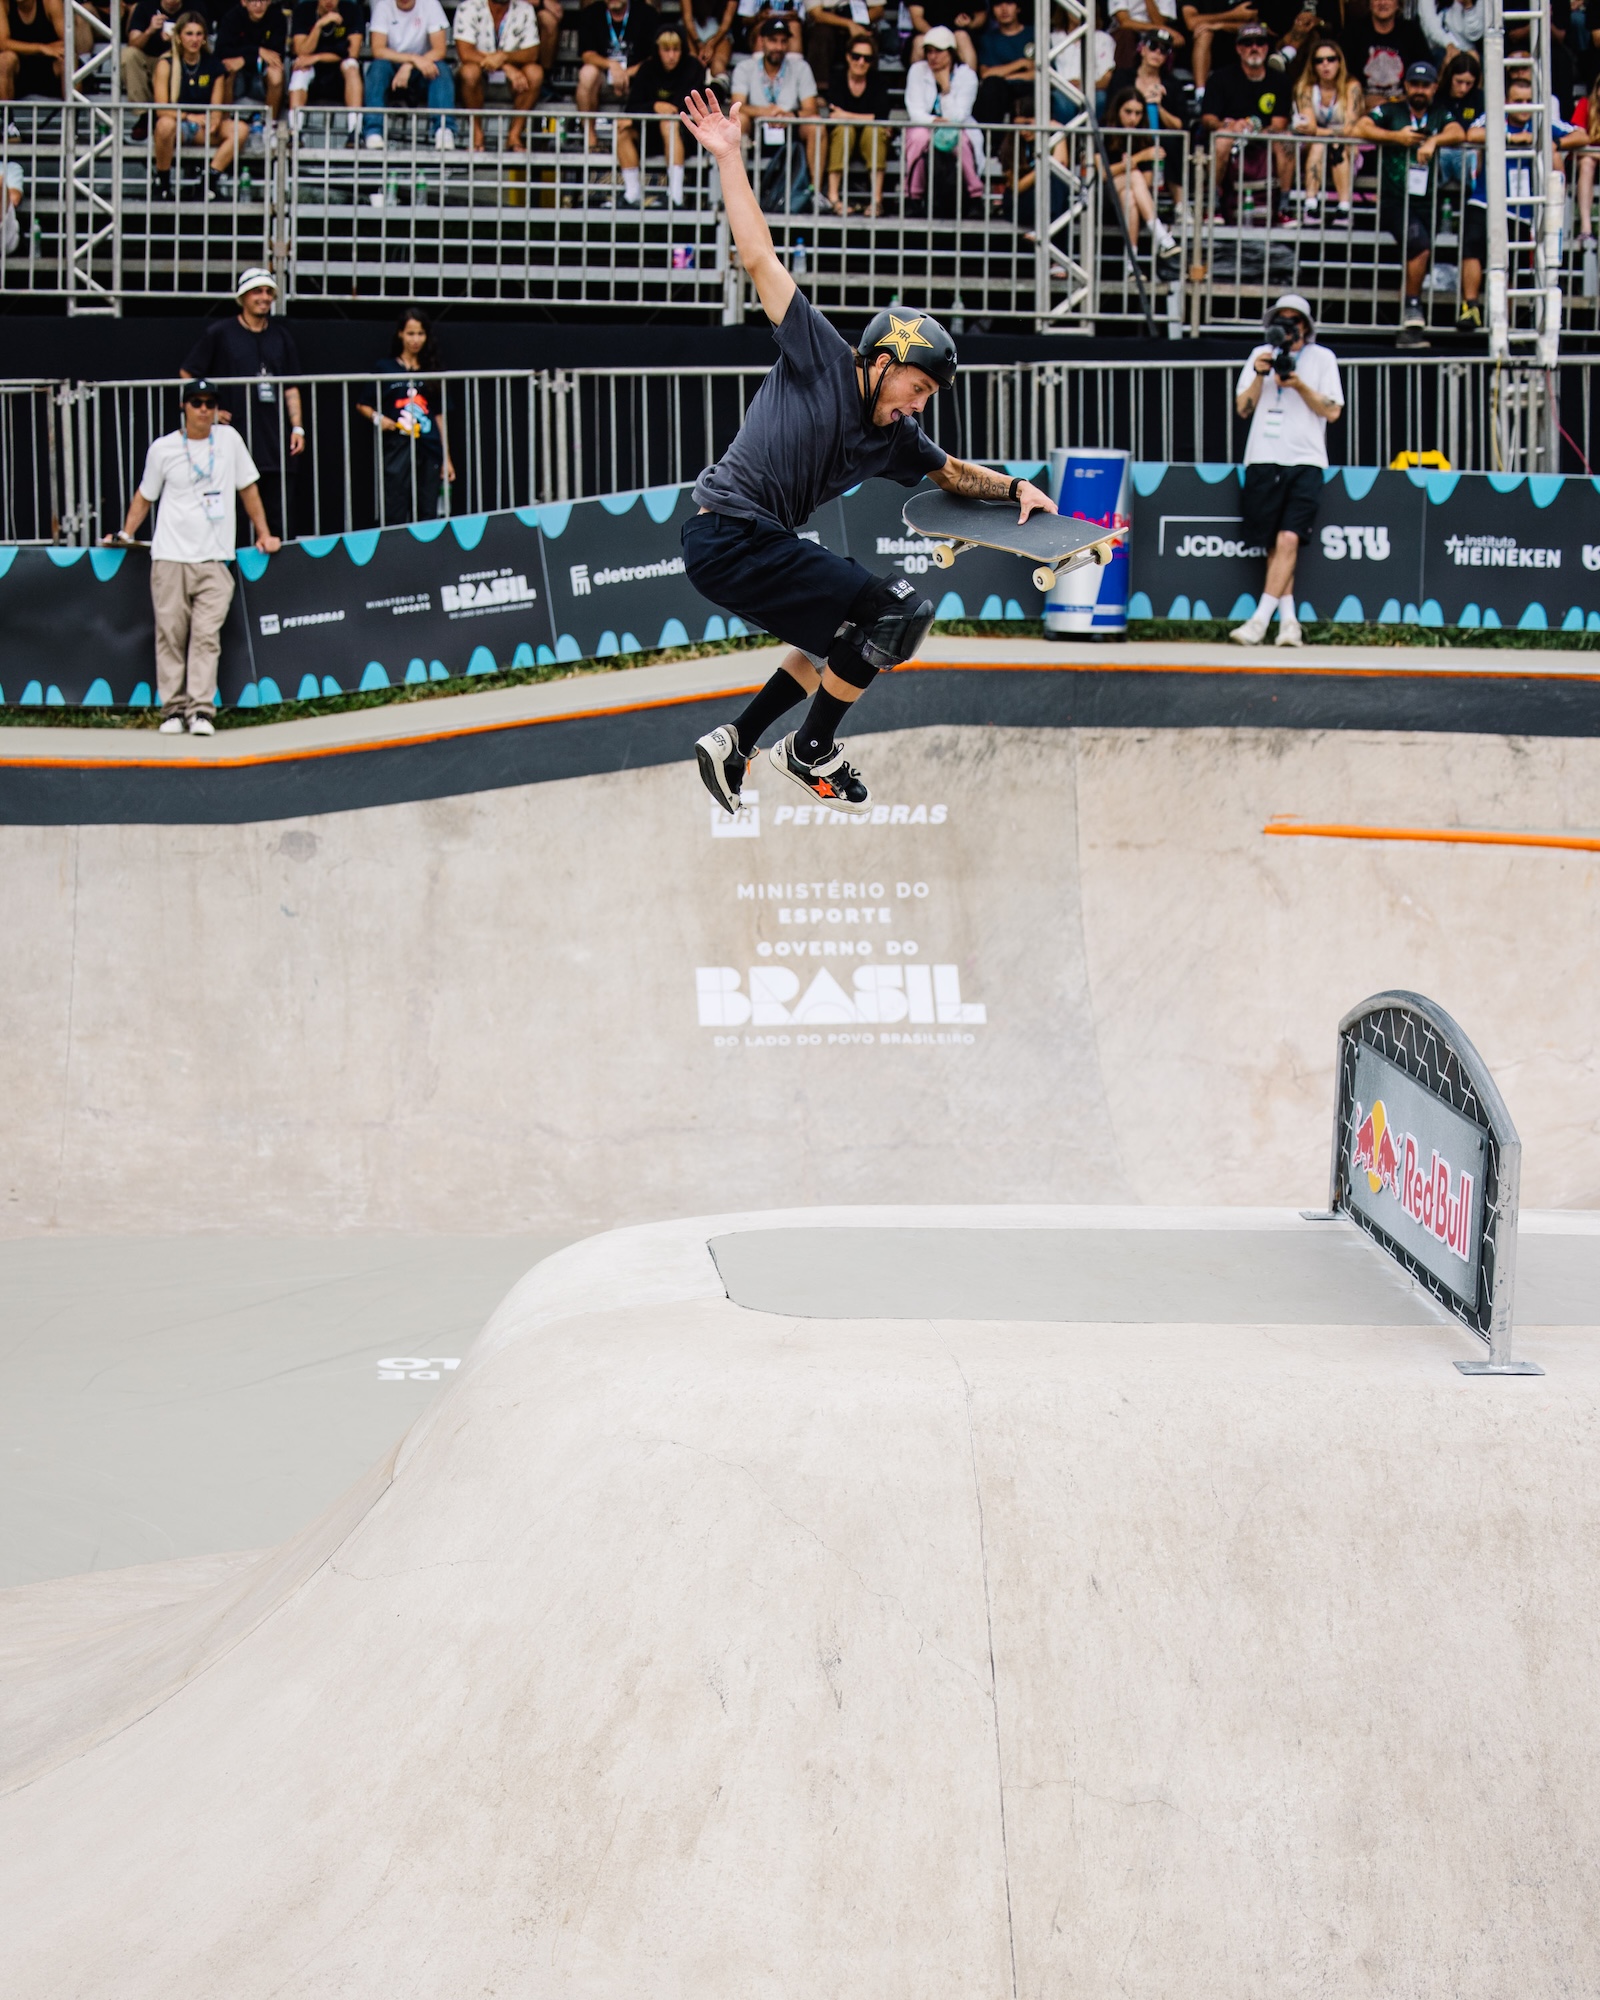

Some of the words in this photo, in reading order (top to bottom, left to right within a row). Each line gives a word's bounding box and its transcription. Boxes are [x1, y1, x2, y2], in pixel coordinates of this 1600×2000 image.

[1320, 524, 1391, 561] STU
[1465, 534, 1516, 549] instituto
[1454, 547, 1561, 568] HEINEKEN
[593, 556, 686, 586] eletromidi
[440, 575, 537, 612] BRASIL
[283, 609, 345, 628] PETROBRAS
[736, 879, 885, 900] MINISTÉRIO
[895, 881, 929, 899] DO
[778, 907, 892, 925] ESPORTE
[756, 940, 873, 957] GOVERNO
[885, 940, 919, 956] DO
[694, 963, 987, 1028] BRASIL
[713, 1034, 740, 1047] DO
[744, 1034, 792, 1047] LADO
[796, 1033, 823, 1046] DO
[827, 1032, 876, 1045] POVO
[879, 1031, 976, 1045] BRASILEIRO
